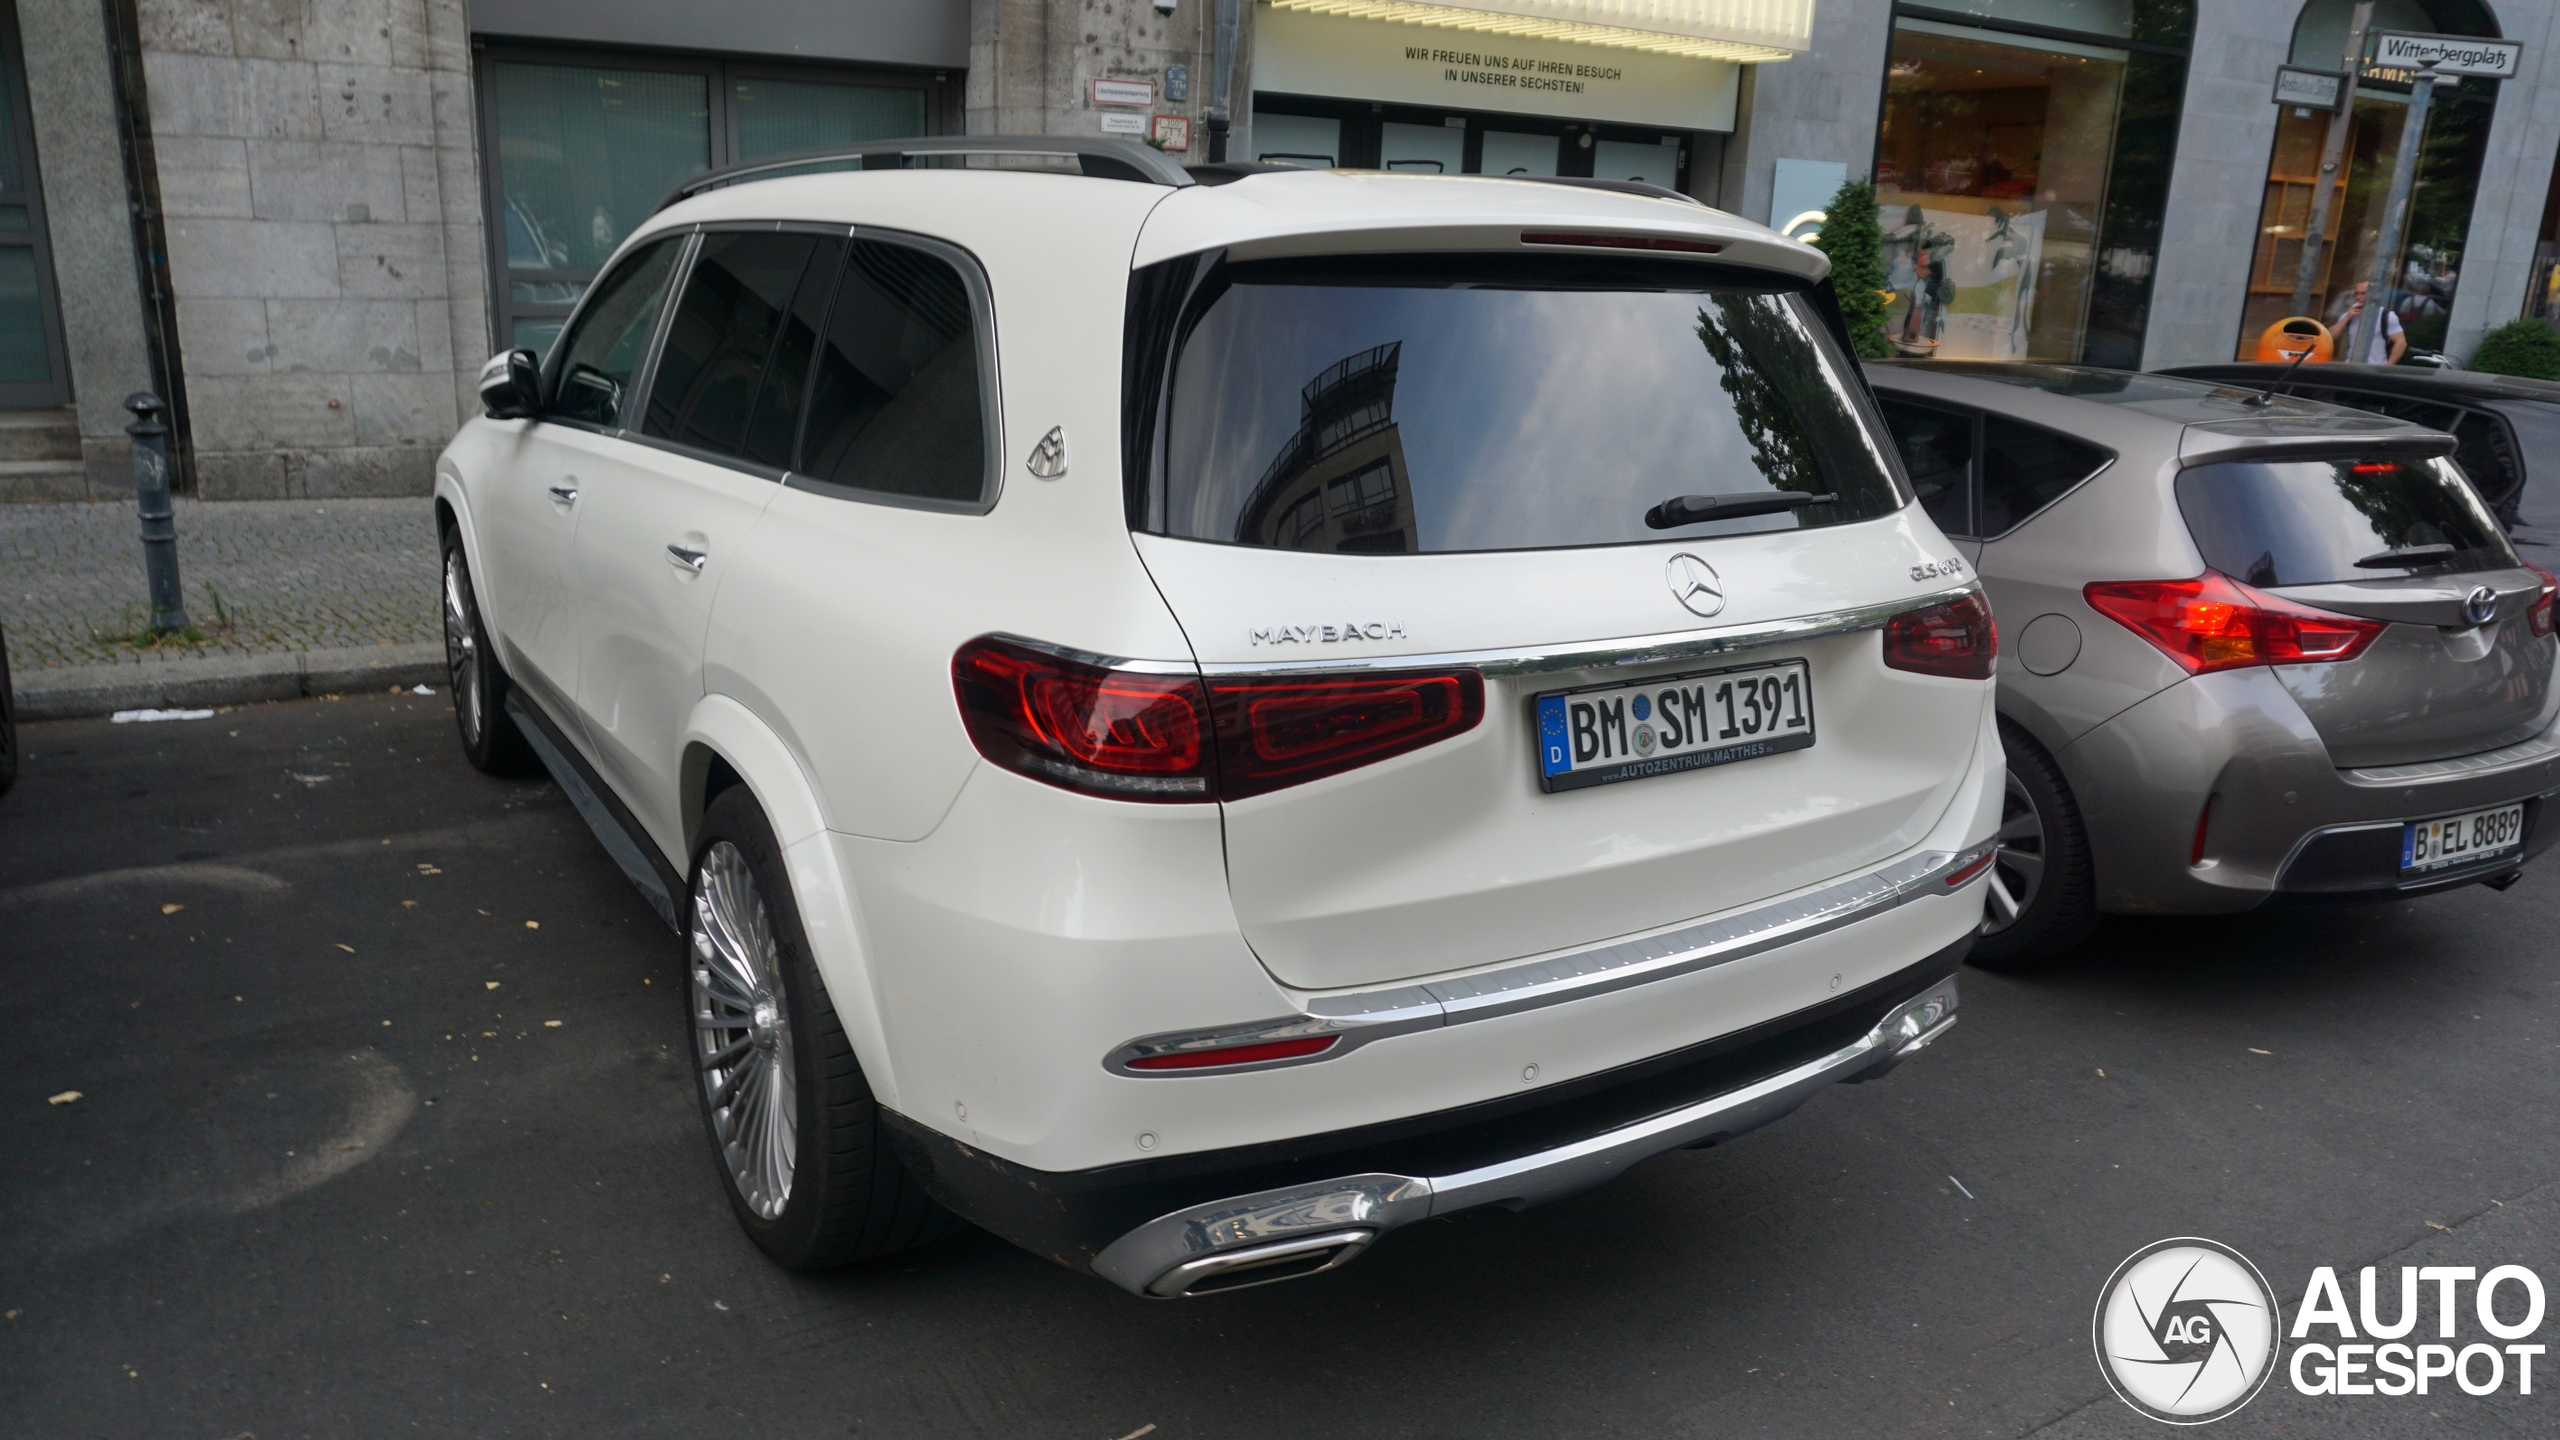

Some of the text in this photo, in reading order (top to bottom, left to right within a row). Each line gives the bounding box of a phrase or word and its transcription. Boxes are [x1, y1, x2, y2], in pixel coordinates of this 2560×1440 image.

[1405, 46, 1621, 80] WIR FREUEN UNS AUF IHREN BESUCH
[1444, 68, 1585, 94] IN UNSERER SECHSTEN!
[1909, 563, 1939, 582] GLS
[1250, 621, 1407, 646] MAYBACH
[1570, 695, 1629, 763] BM
[1657, 685, 1709, 749] SM
[1715, 670, 1806, 740] 1391
[1551, 746, 1563, 764] D
[2415, 808, 2521, 861] B EL 8889
